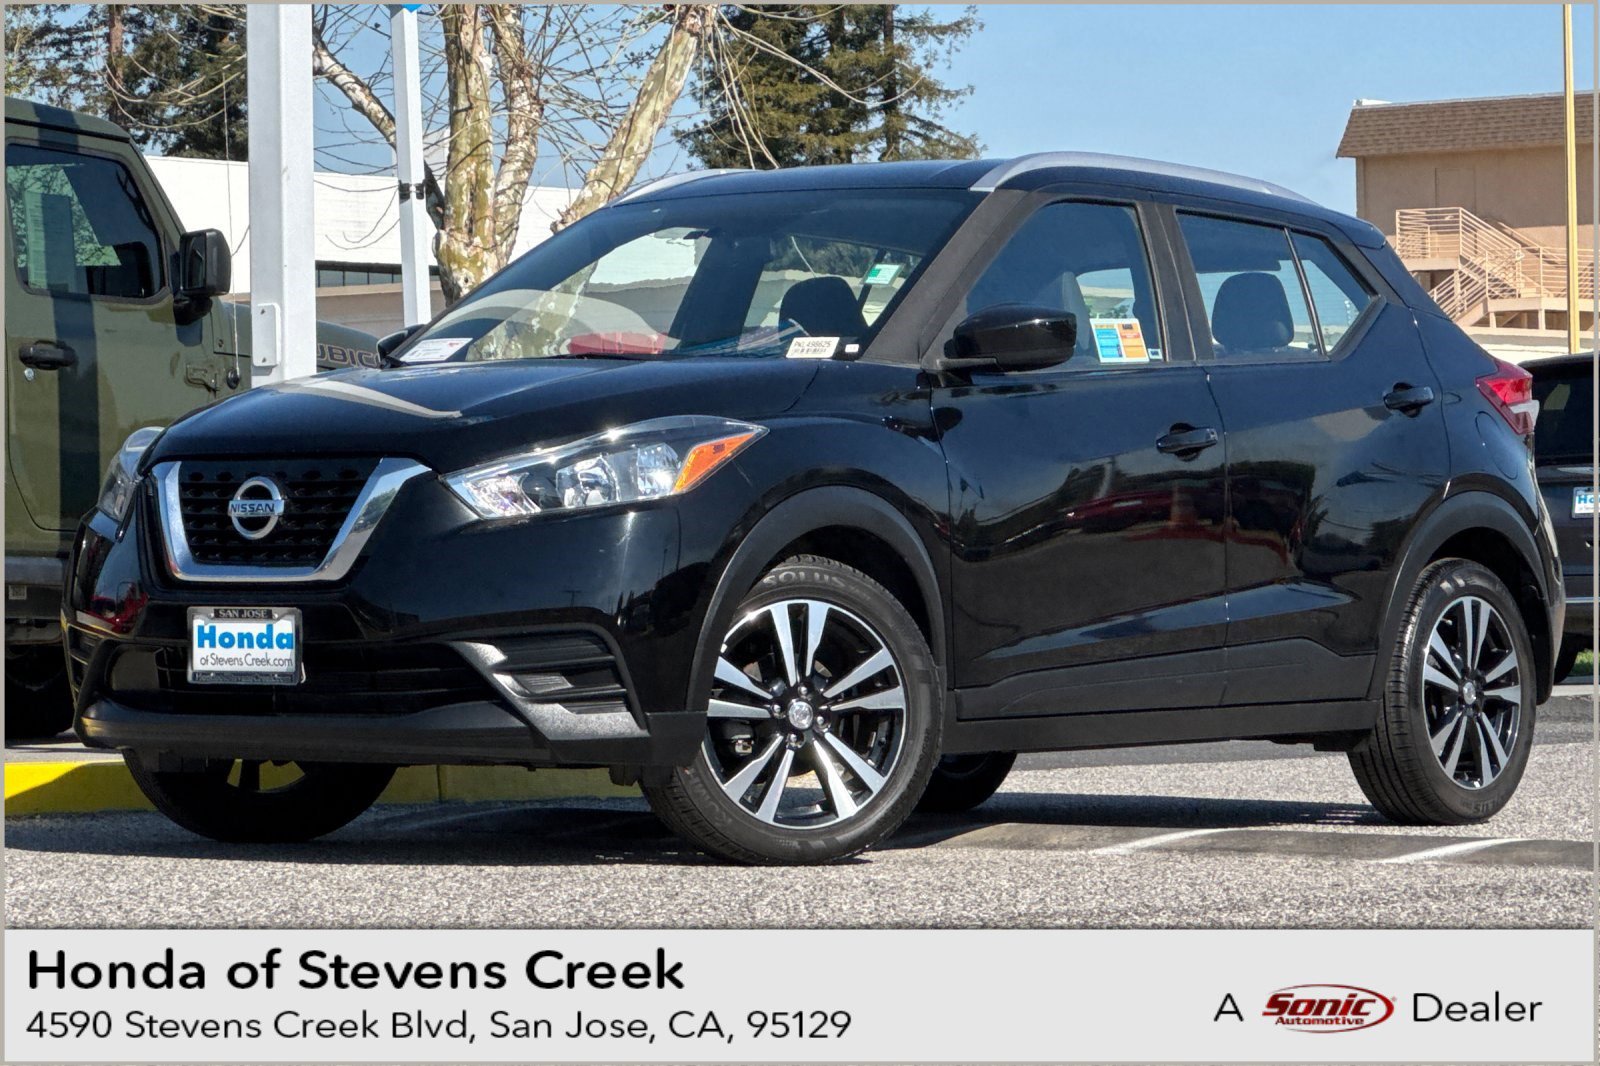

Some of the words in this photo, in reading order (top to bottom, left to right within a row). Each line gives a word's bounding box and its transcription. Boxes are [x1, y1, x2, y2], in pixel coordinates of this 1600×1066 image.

[230, 503, 275, 513] NISSAN
[763, 571, 846, 588] SOLUS
[218, 609, 239, 618] SAN
[241, 609, 268, 618] JOSE
[197, 623, 293, 649] Honda
[200, 654, 209, 666] of
[683, 767, 733, 828] KUMH
